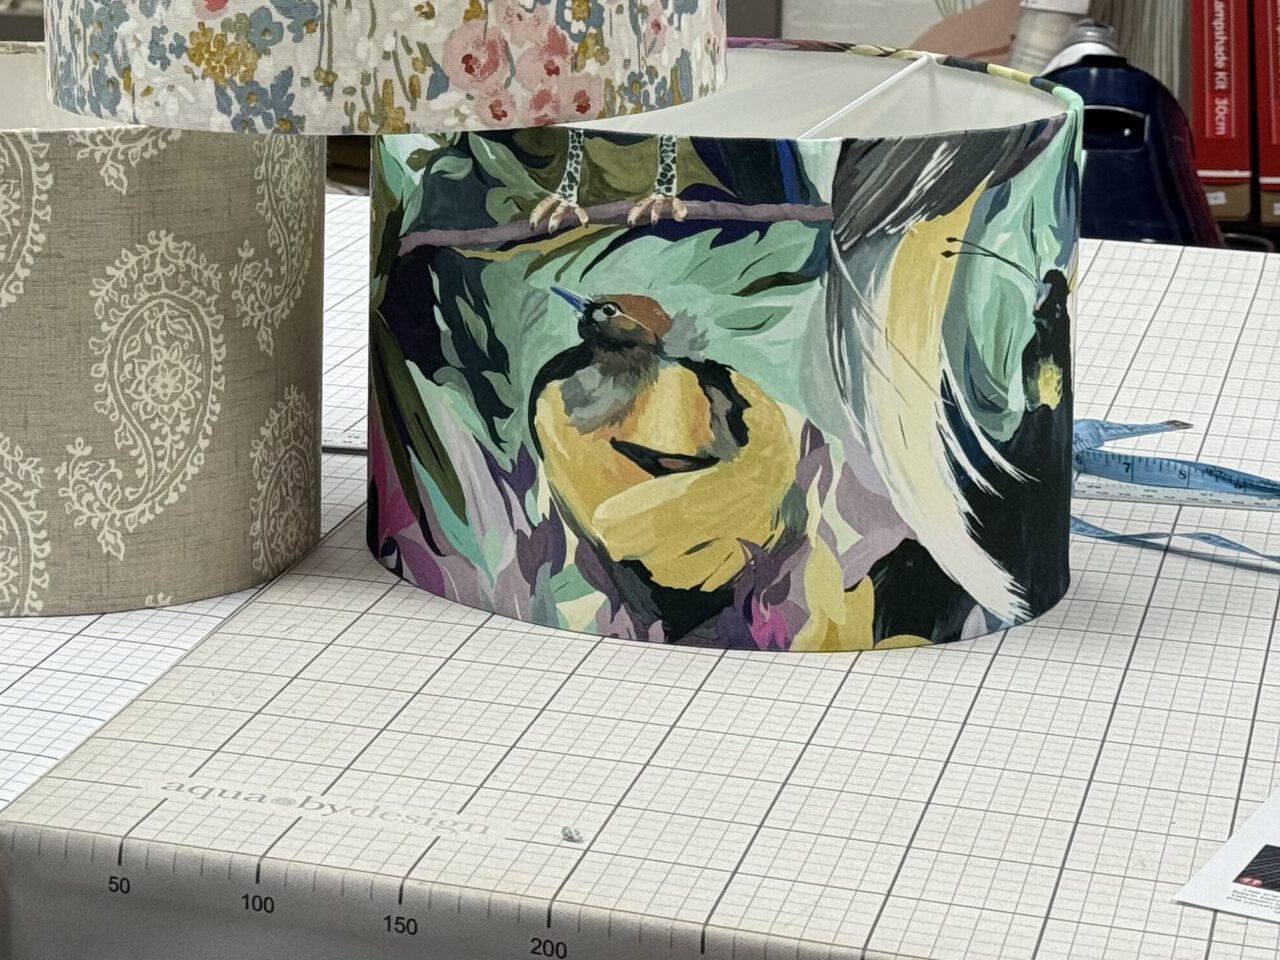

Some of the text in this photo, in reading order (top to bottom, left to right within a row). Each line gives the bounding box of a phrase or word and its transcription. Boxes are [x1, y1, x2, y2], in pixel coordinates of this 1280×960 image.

[1214, 71, 1229, 91] Kit
[1214, 97, 1229, 136] 30cm
[1122, 461, 1132, 474] 7
[1177, 469, 1188, 480] 8
[108, 875, 131, 895] 50
[241, 893, 275, 914] 100
[383, 914, 418, 936] 150
[530, 937, 568, 960] 200
